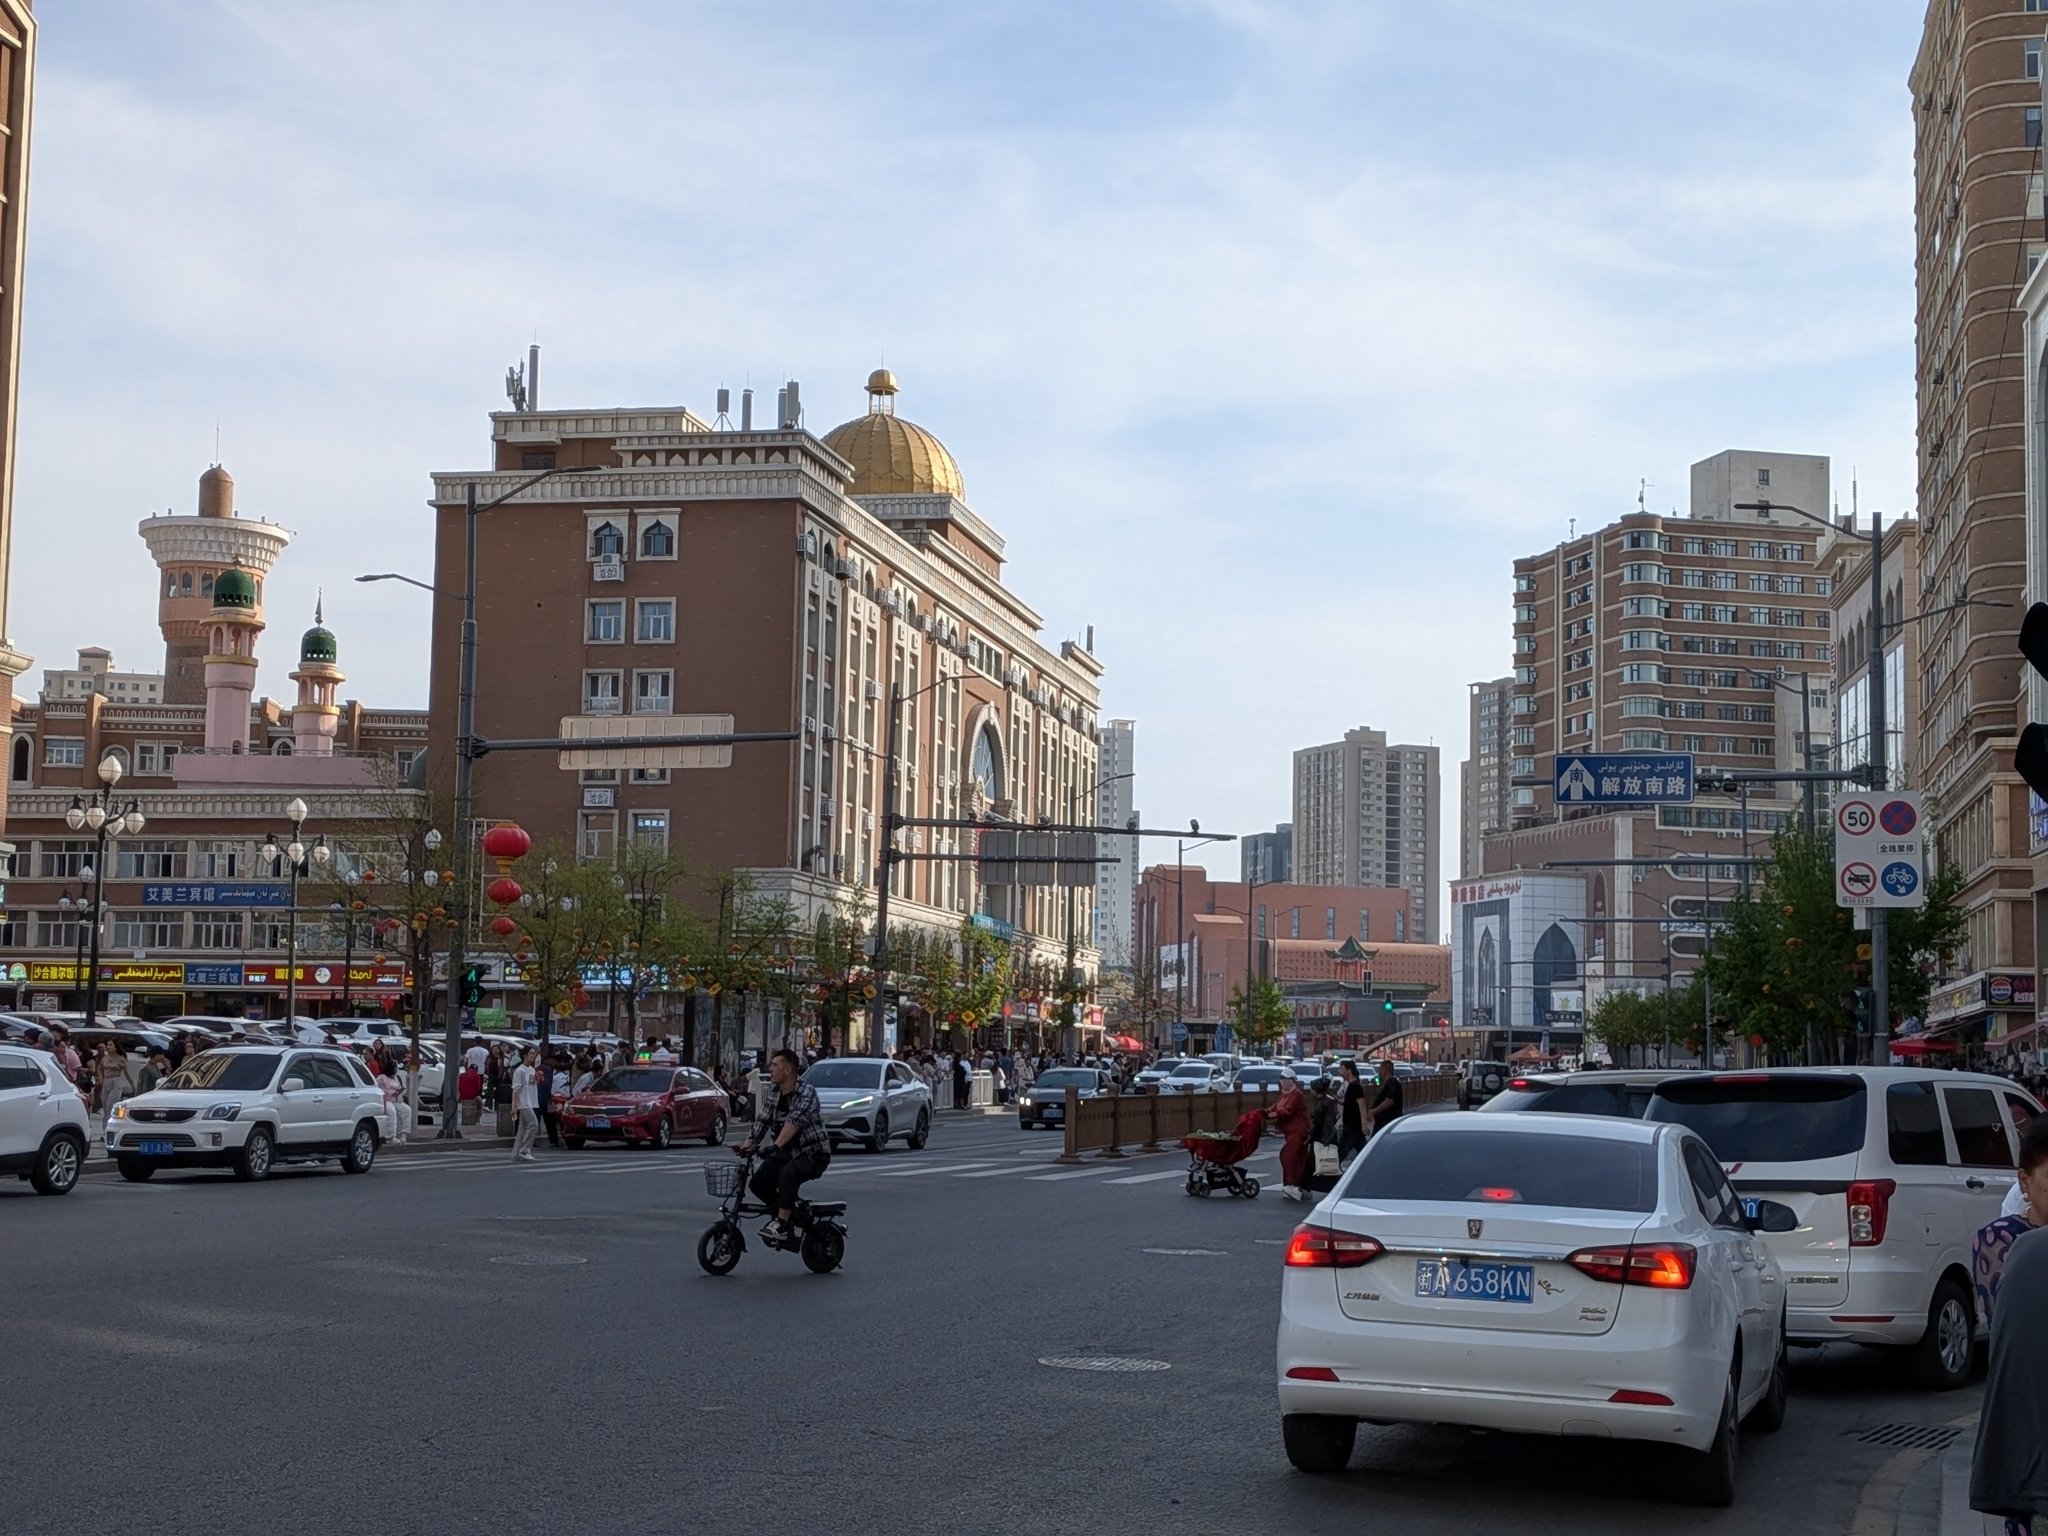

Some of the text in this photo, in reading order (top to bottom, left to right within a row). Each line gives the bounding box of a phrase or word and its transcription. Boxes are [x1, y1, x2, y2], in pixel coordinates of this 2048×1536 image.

[1569, 767, 1584, 783] 南
[1601, 776, 1686, 796] 解放南路
[1847, 811, 1869, 827] 50
[1880, 844, 1915, 853] 全线禁停
[147, 887, 216, 901] 艾美兰宾馆
